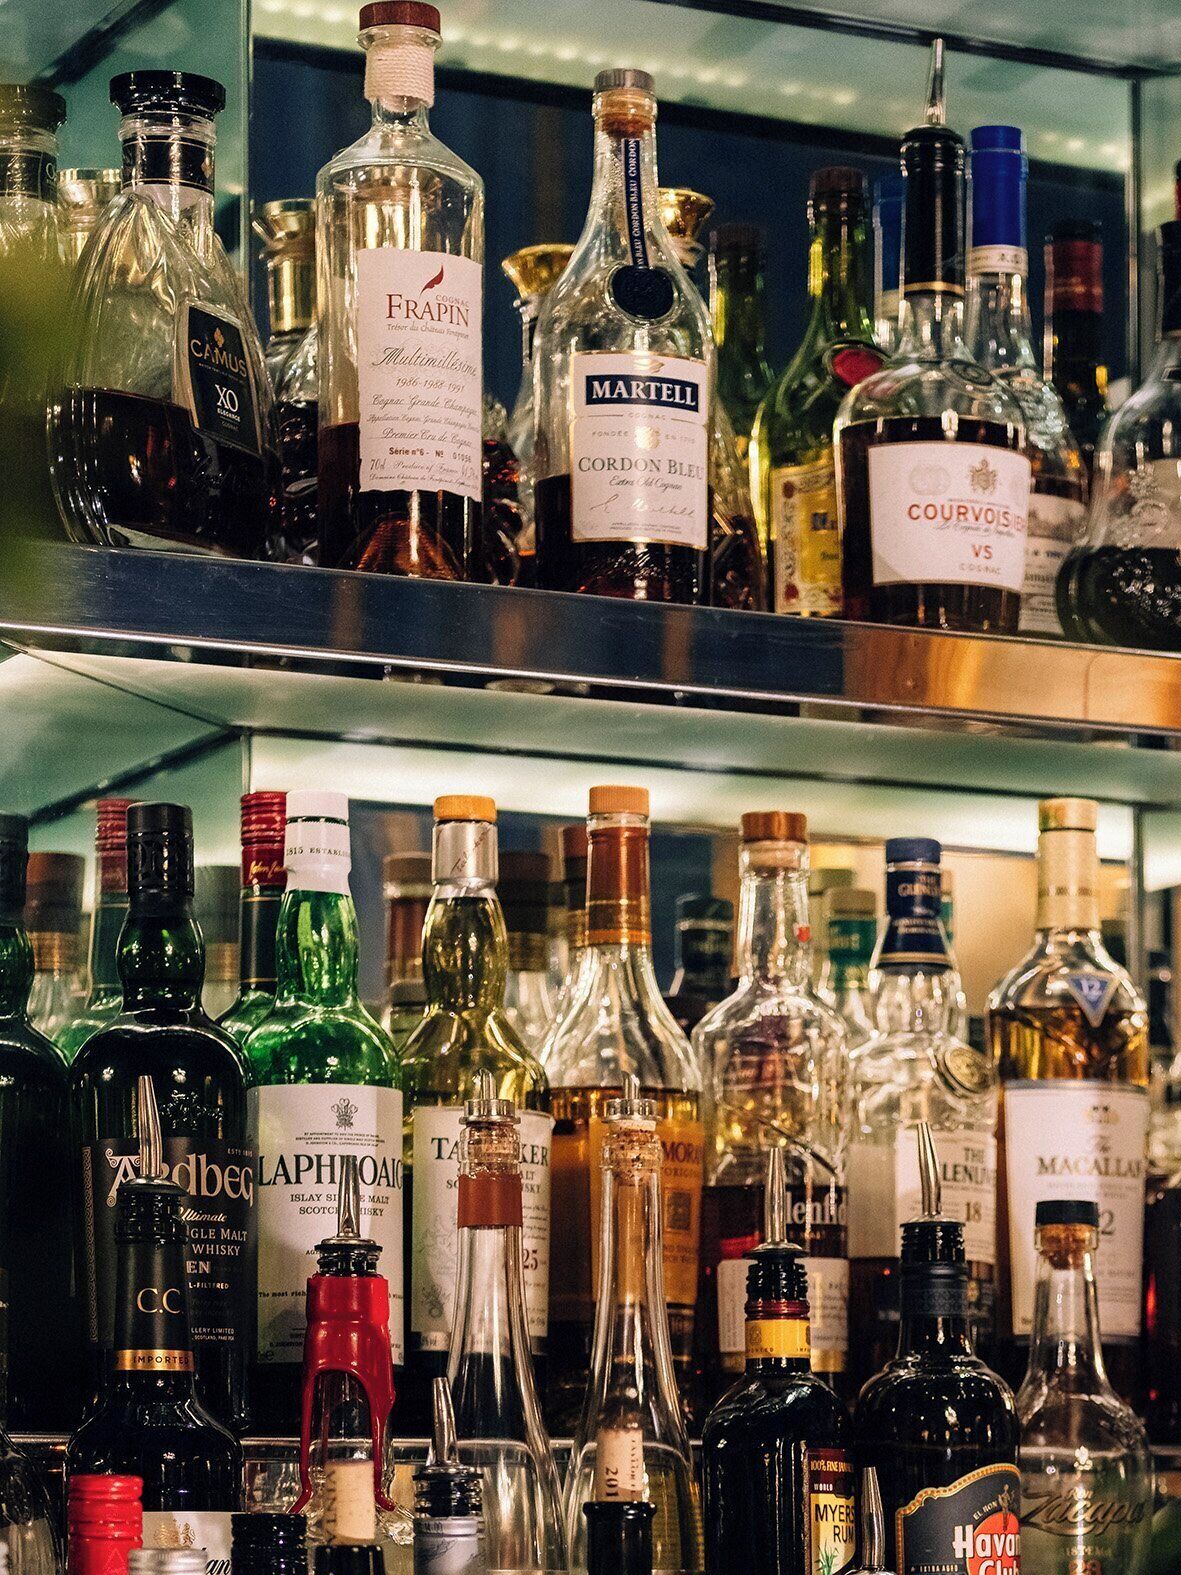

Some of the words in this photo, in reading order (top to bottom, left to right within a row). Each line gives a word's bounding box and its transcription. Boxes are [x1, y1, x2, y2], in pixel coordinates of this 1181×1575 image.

[435, 294, 470, 308] COGNAC
[386, 293, 470, 327] FRAPIN
[190, 339, 248, 378] CAMUS
[215, 383, 239, 413] XO
[592, 380, 696, 406] MARTELL
[371, 394, 405, 411] Cognac
[382, 427, 419, 440] Premier
[389, 447, 409, 456] Série
[578, 457, 661, 473] CORDON
[971, 544, 994, 560] VS
[290, 1194, 322, 1203] ISLAY
[368, 1195, 389, 1205] MALT
[965, 1202, 982, 1222] 18
[220, 1227, 248, 1242] MALT
[192, 1244, 241, 1257] WHISKY
[132, 1355, 190, 1365] IMPORTED
